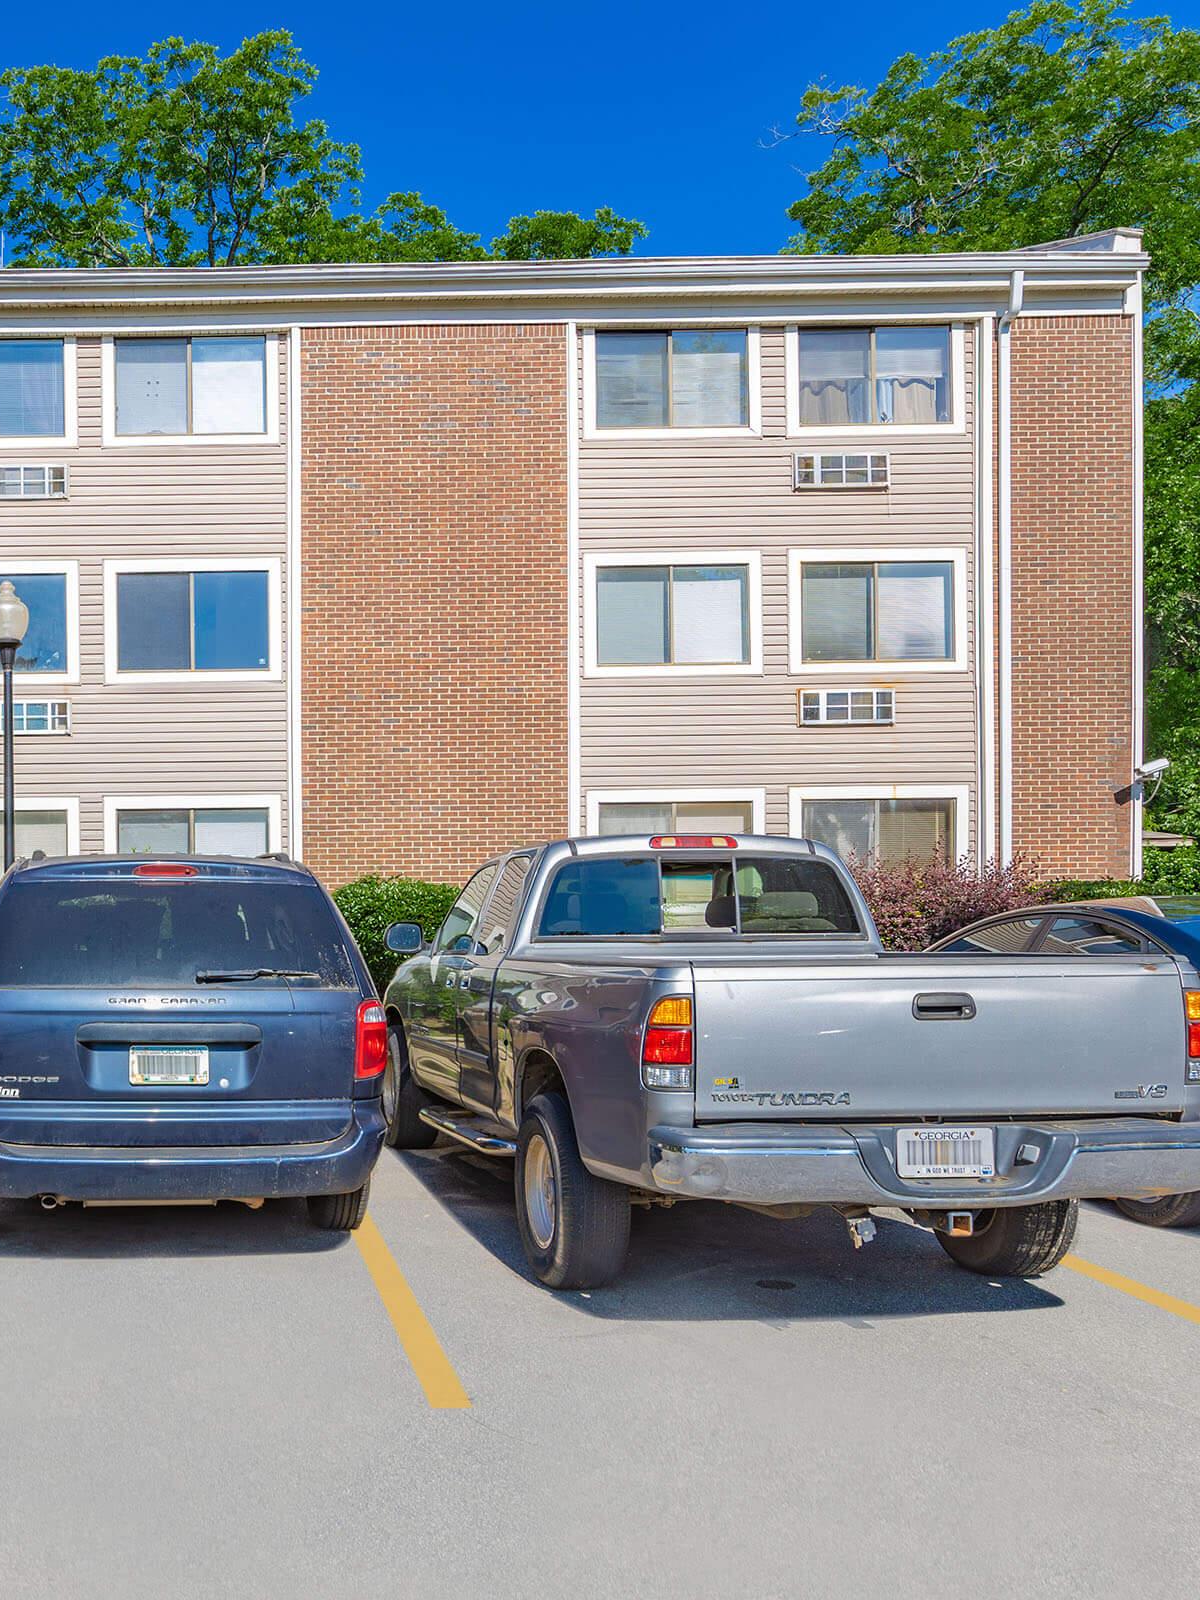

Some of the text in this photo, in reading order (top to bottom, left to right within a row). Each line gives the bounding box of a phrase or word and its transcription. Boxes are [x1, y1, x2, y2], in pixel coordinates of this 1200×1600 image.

[108, 997, 153, 1005] GRAN
[1138, 1085, 1168, 1099] V8
[753, 1092, 851, 1106] TUNDRA
[919, 1131, 970, 1140] GEORGIA
